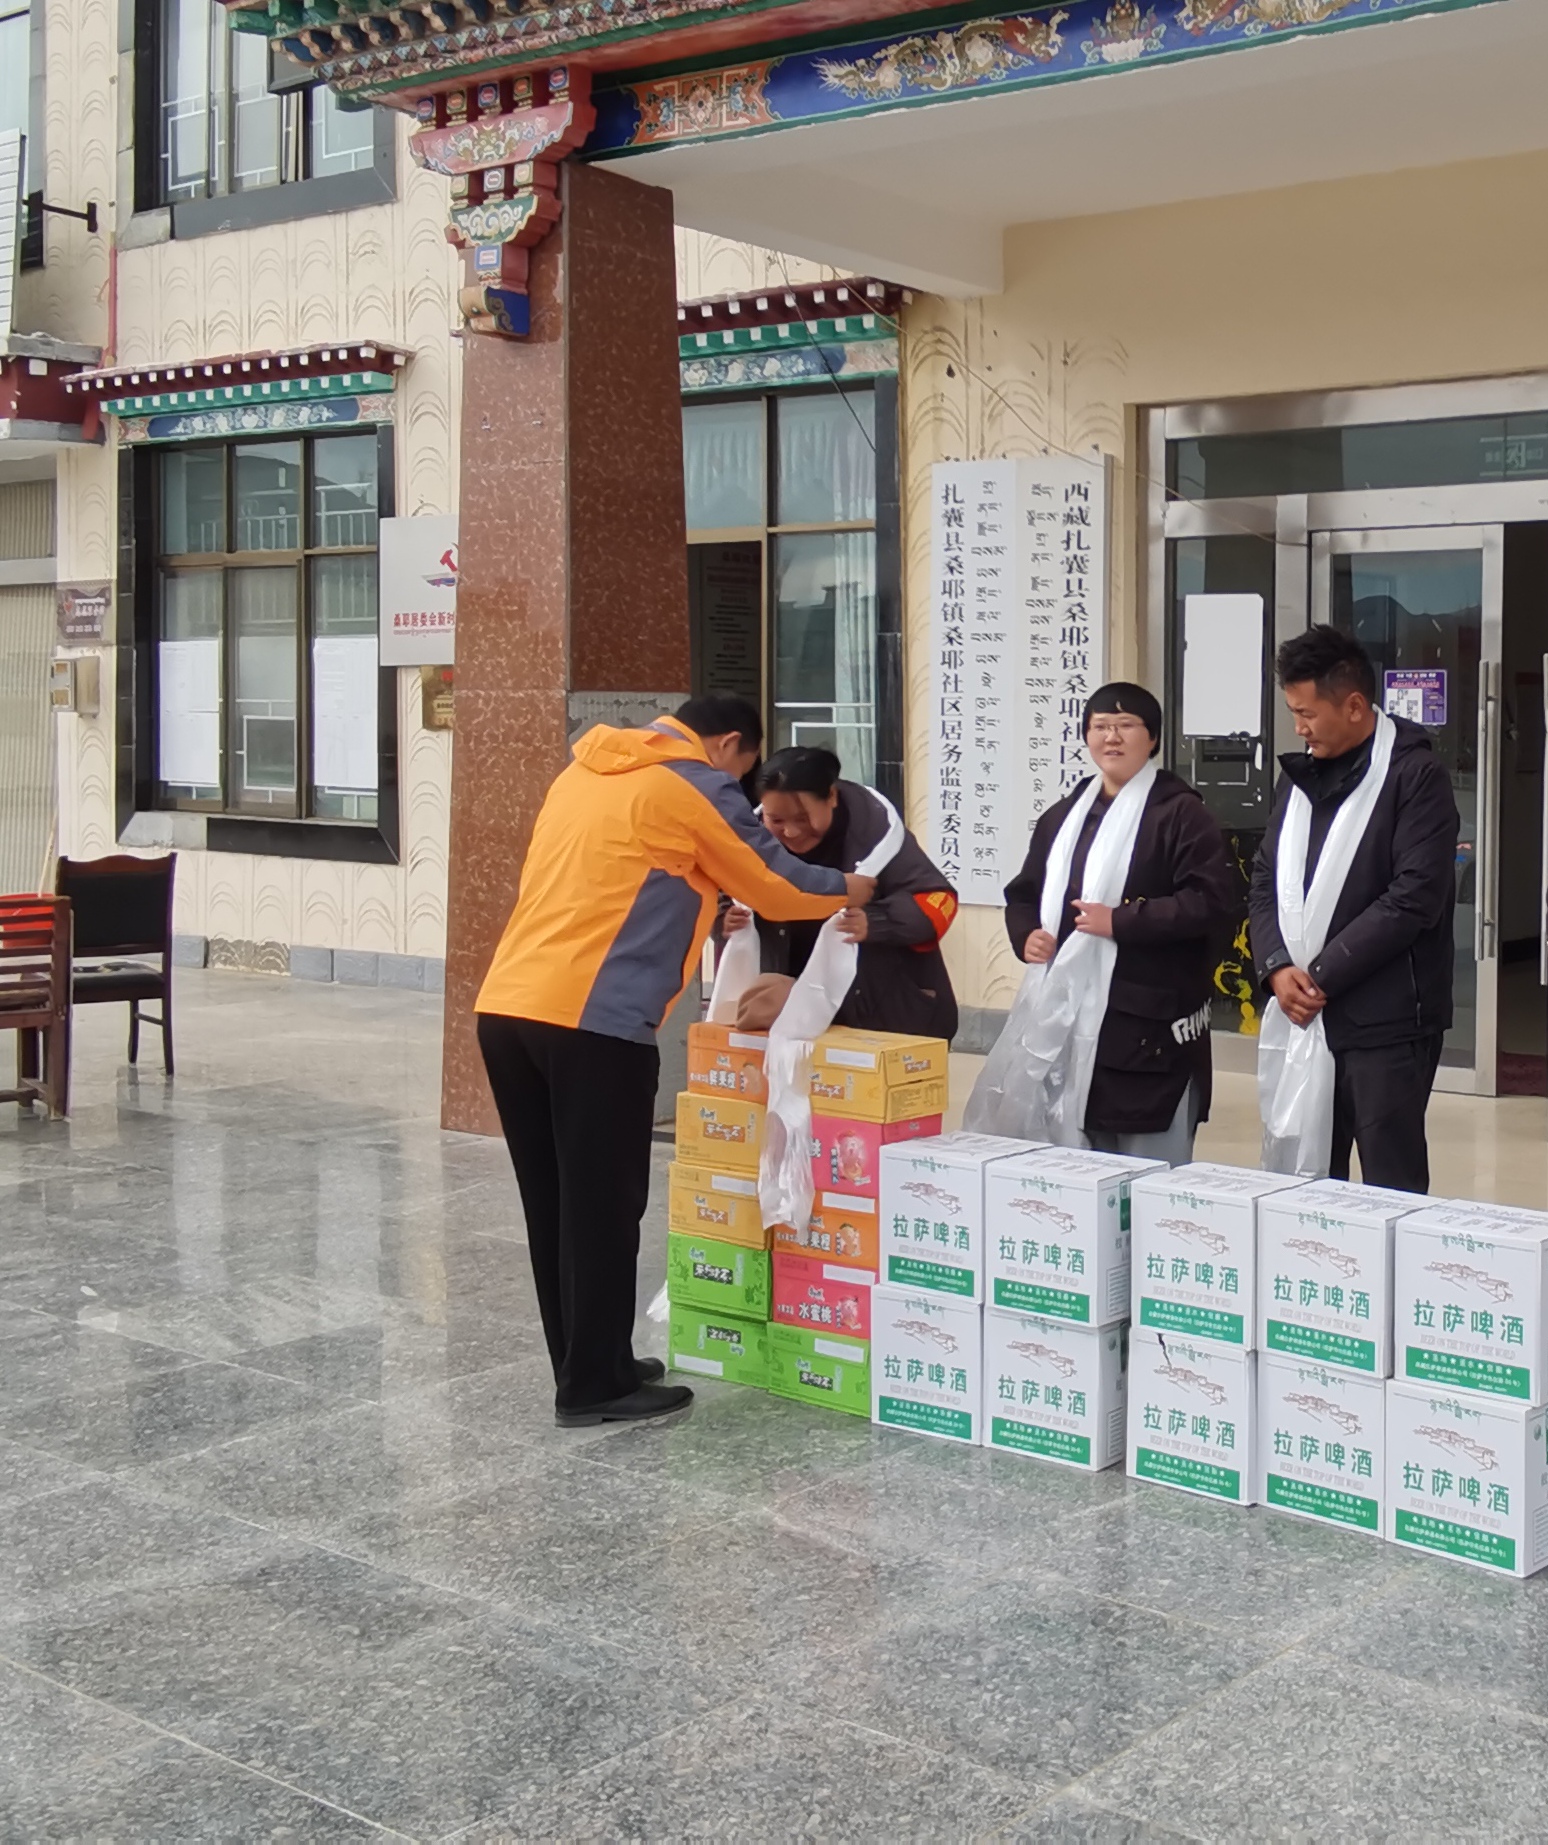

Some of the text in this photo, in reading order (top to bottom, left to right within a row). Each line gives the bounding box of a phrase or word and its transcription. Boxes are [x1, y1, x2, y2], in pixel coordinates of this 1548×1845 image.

[1058, 481, 1092, 799] 西藏扎囊县桑耶镇桑耶社区居
[940, 483, 965, 882] 扎囊县桑耶镇桑耶社区居务监督委员会
[893, 1213, 970, 1251] 拉萨啤酒
[999, 1235, 1084, 1275] 拉萨啤酒
[1147, 1252, 1238, 1294] 拉萨啤酒
[1274, 1273, 1370, 1320] 拉萨啤酒
[799, 1302, 832, 1324] 水蜜桃
[1413, 1298, 1524, 1346] 拉萨啤酒
[884, 1354, 967, 1394] 拉萨啤酒
[998, 1374, 1086, 1417] 拉萨啤酒
[1143, 1402, 1235, 1450] 拉萨啤酒
[1274, 1427, 1372, 1478] 拉萨啤酒
[1402, 1461, 1509, 1516] 拉萨啤酒
